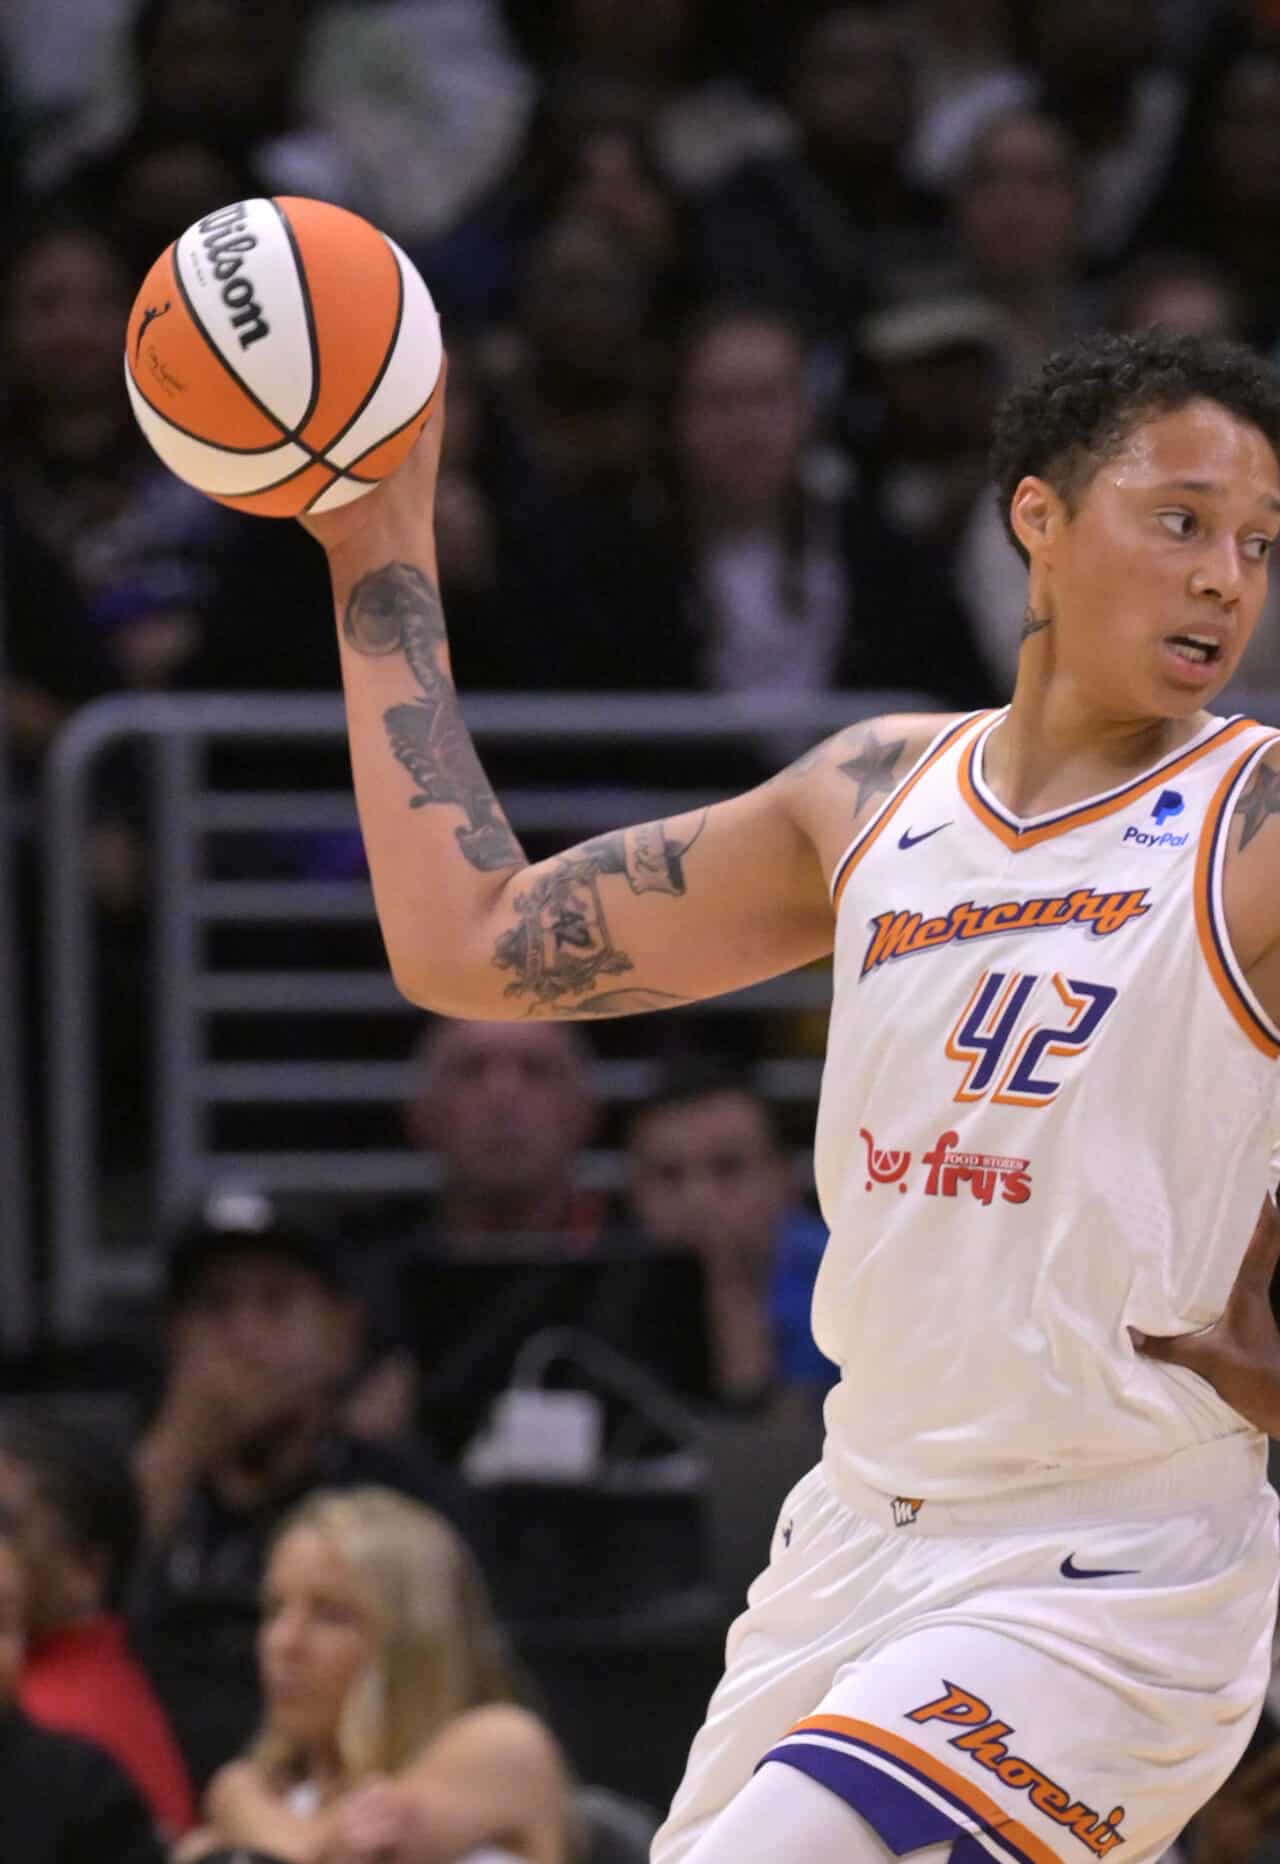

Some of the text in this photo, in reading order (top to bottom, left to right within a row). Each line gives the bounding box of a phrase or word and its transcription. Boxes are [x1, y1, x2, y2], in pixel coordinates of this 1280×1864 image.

[1122, 825, 1190, 848] PayPal
[859, 887, 1152, 980] Mercury
[944, 970, 1118, 1108] 42
[921, 1130, 1033, 1207] fry's
[903, 1679, 1127, 1860] Phoenix
